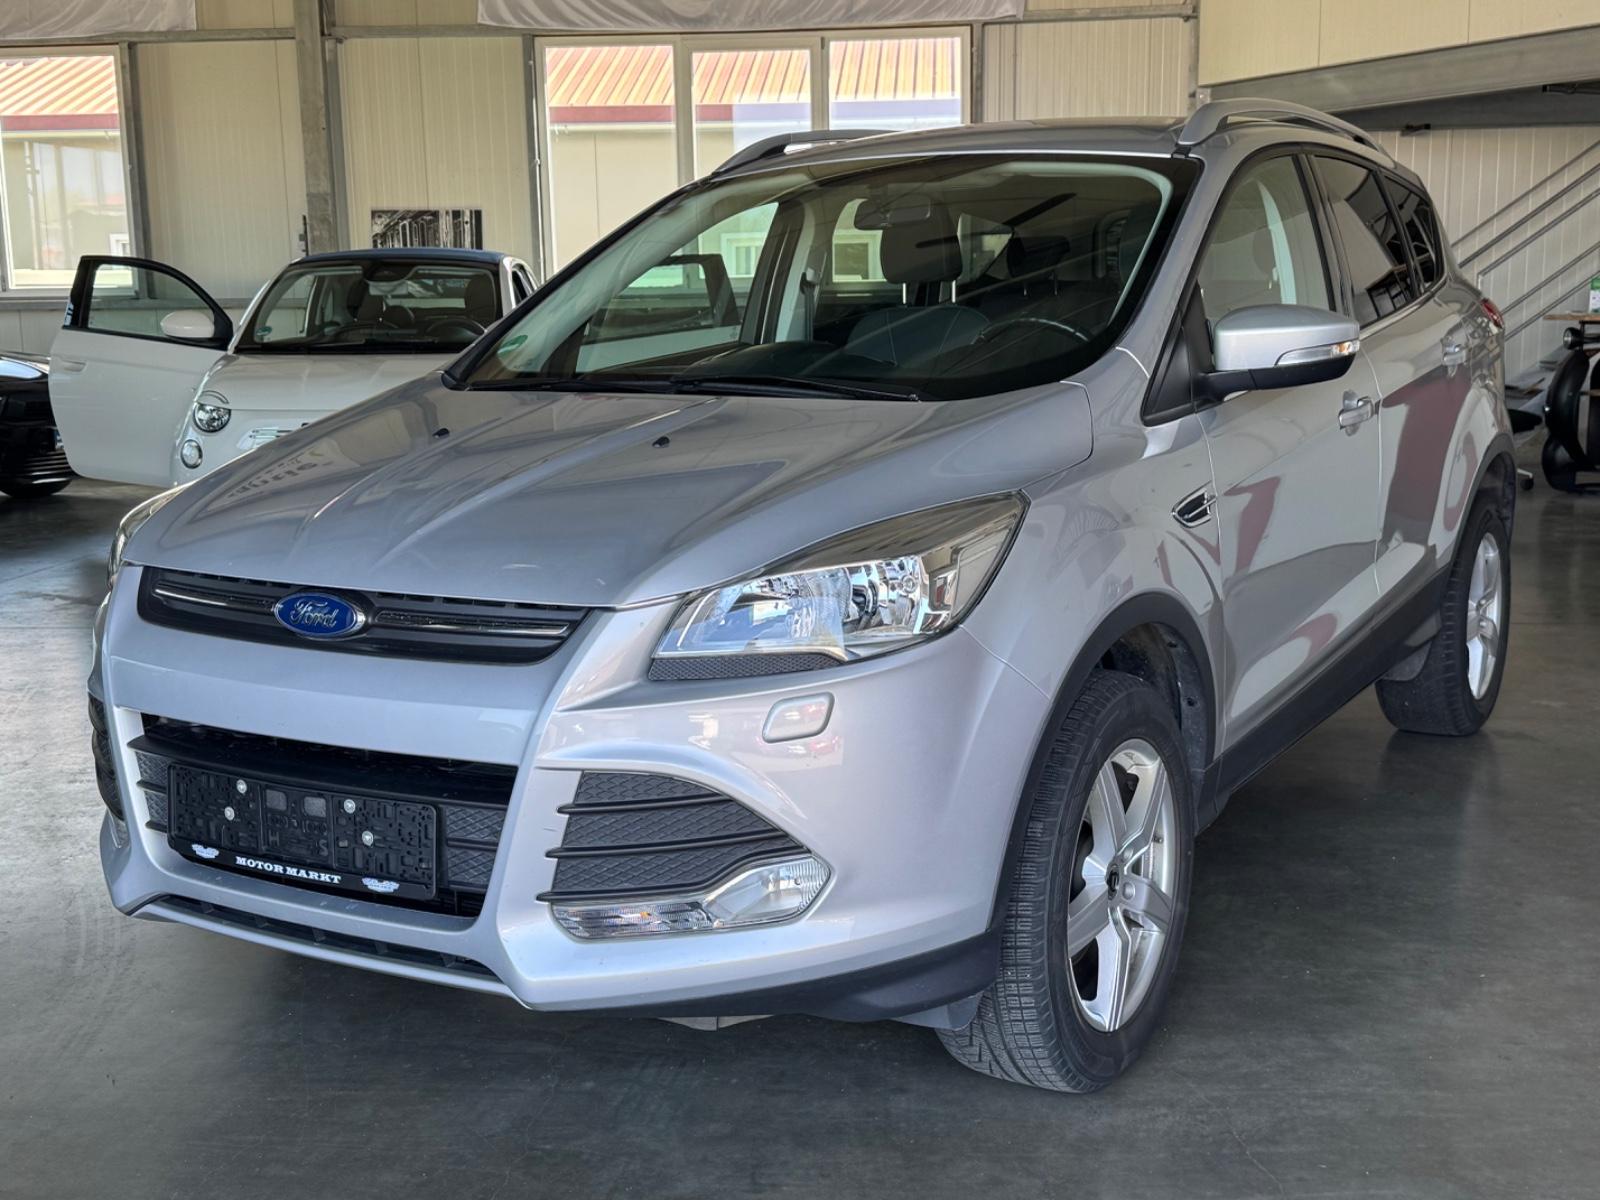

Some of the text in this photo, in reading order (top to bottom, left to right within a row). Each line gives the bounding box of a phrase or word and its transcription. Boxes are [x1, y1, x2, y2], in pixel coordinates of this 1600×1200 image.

[289, 599, 340, 629] Ford
[235, 855, 342, 884] MOTOR MARKT
